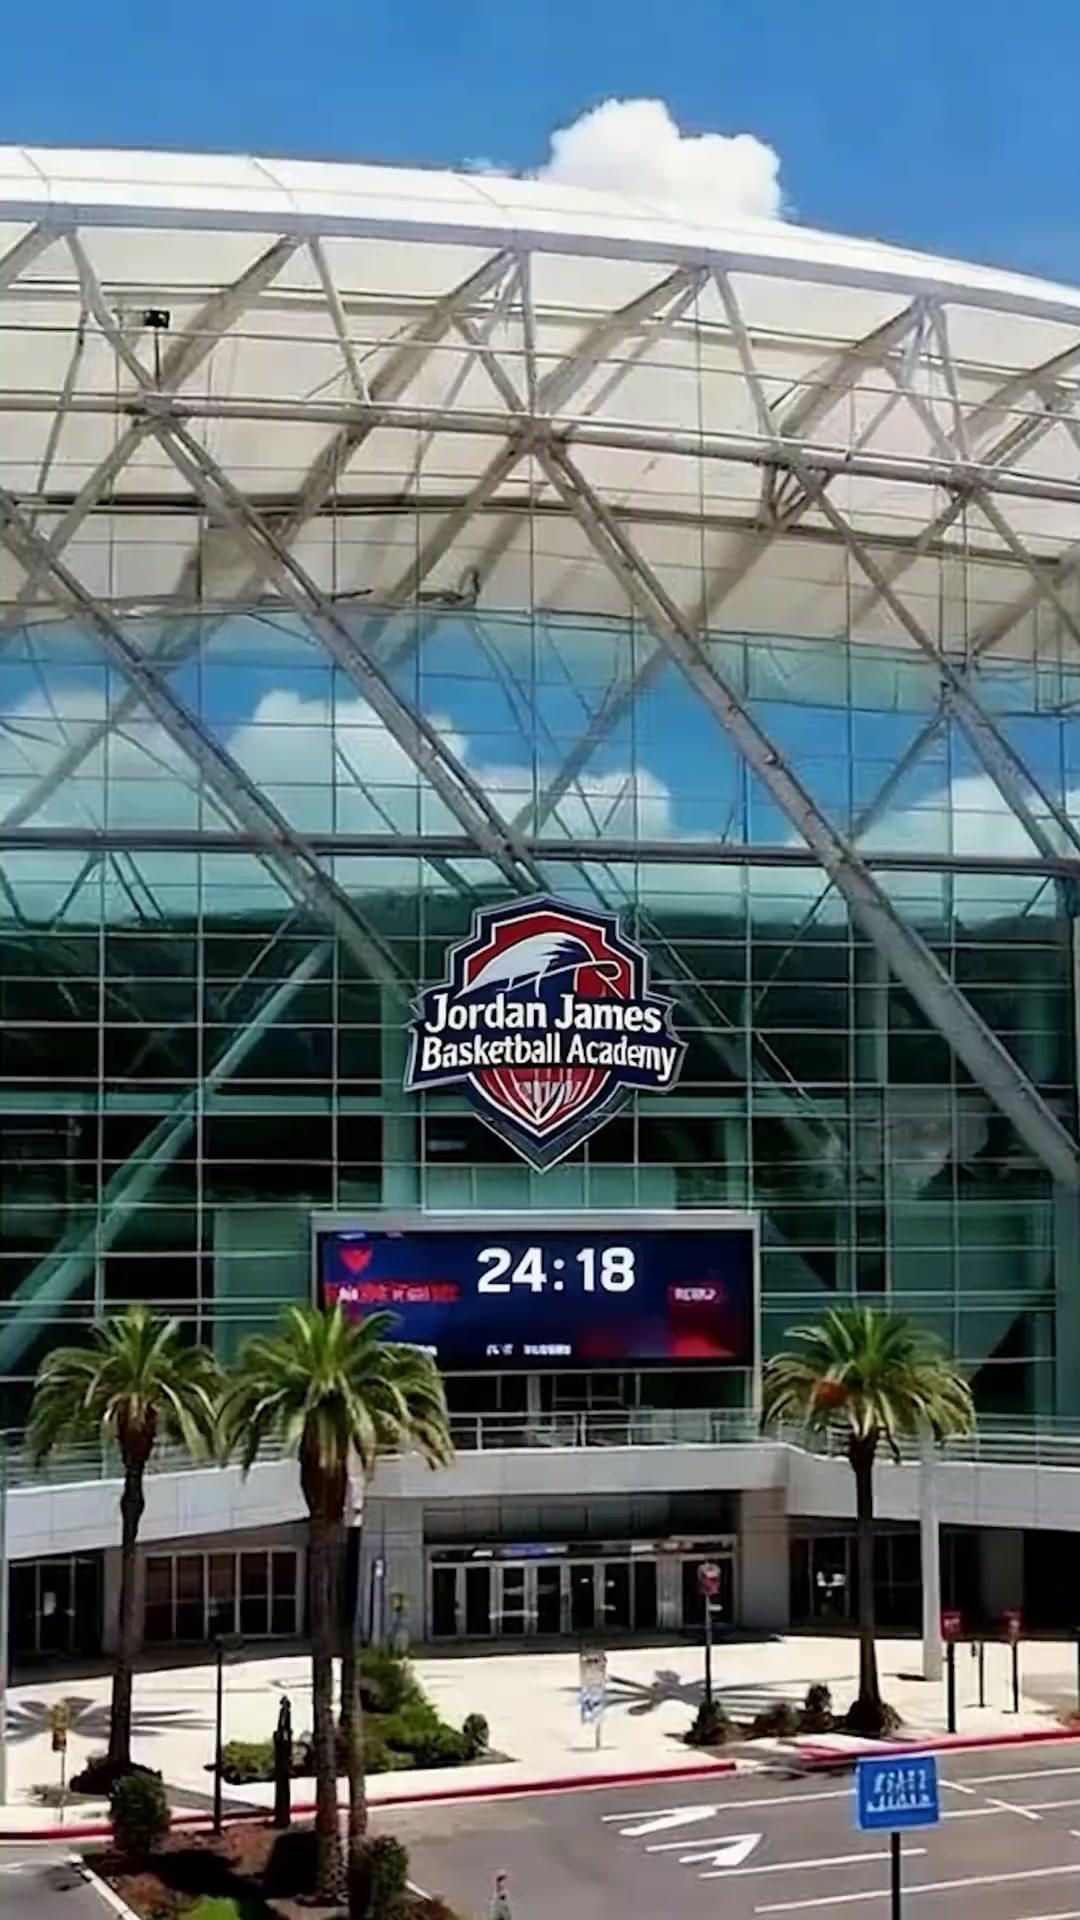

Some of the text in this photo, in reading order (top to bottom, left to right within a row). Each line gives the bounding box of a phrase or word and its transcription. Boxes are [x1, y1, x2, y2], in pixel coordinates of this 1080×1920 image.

[424, 993, 662, 1033] Jordan James
[421, 1033, 677, 1082] Basketball Academy
[476, 1247, 635, 1294] 24:18
